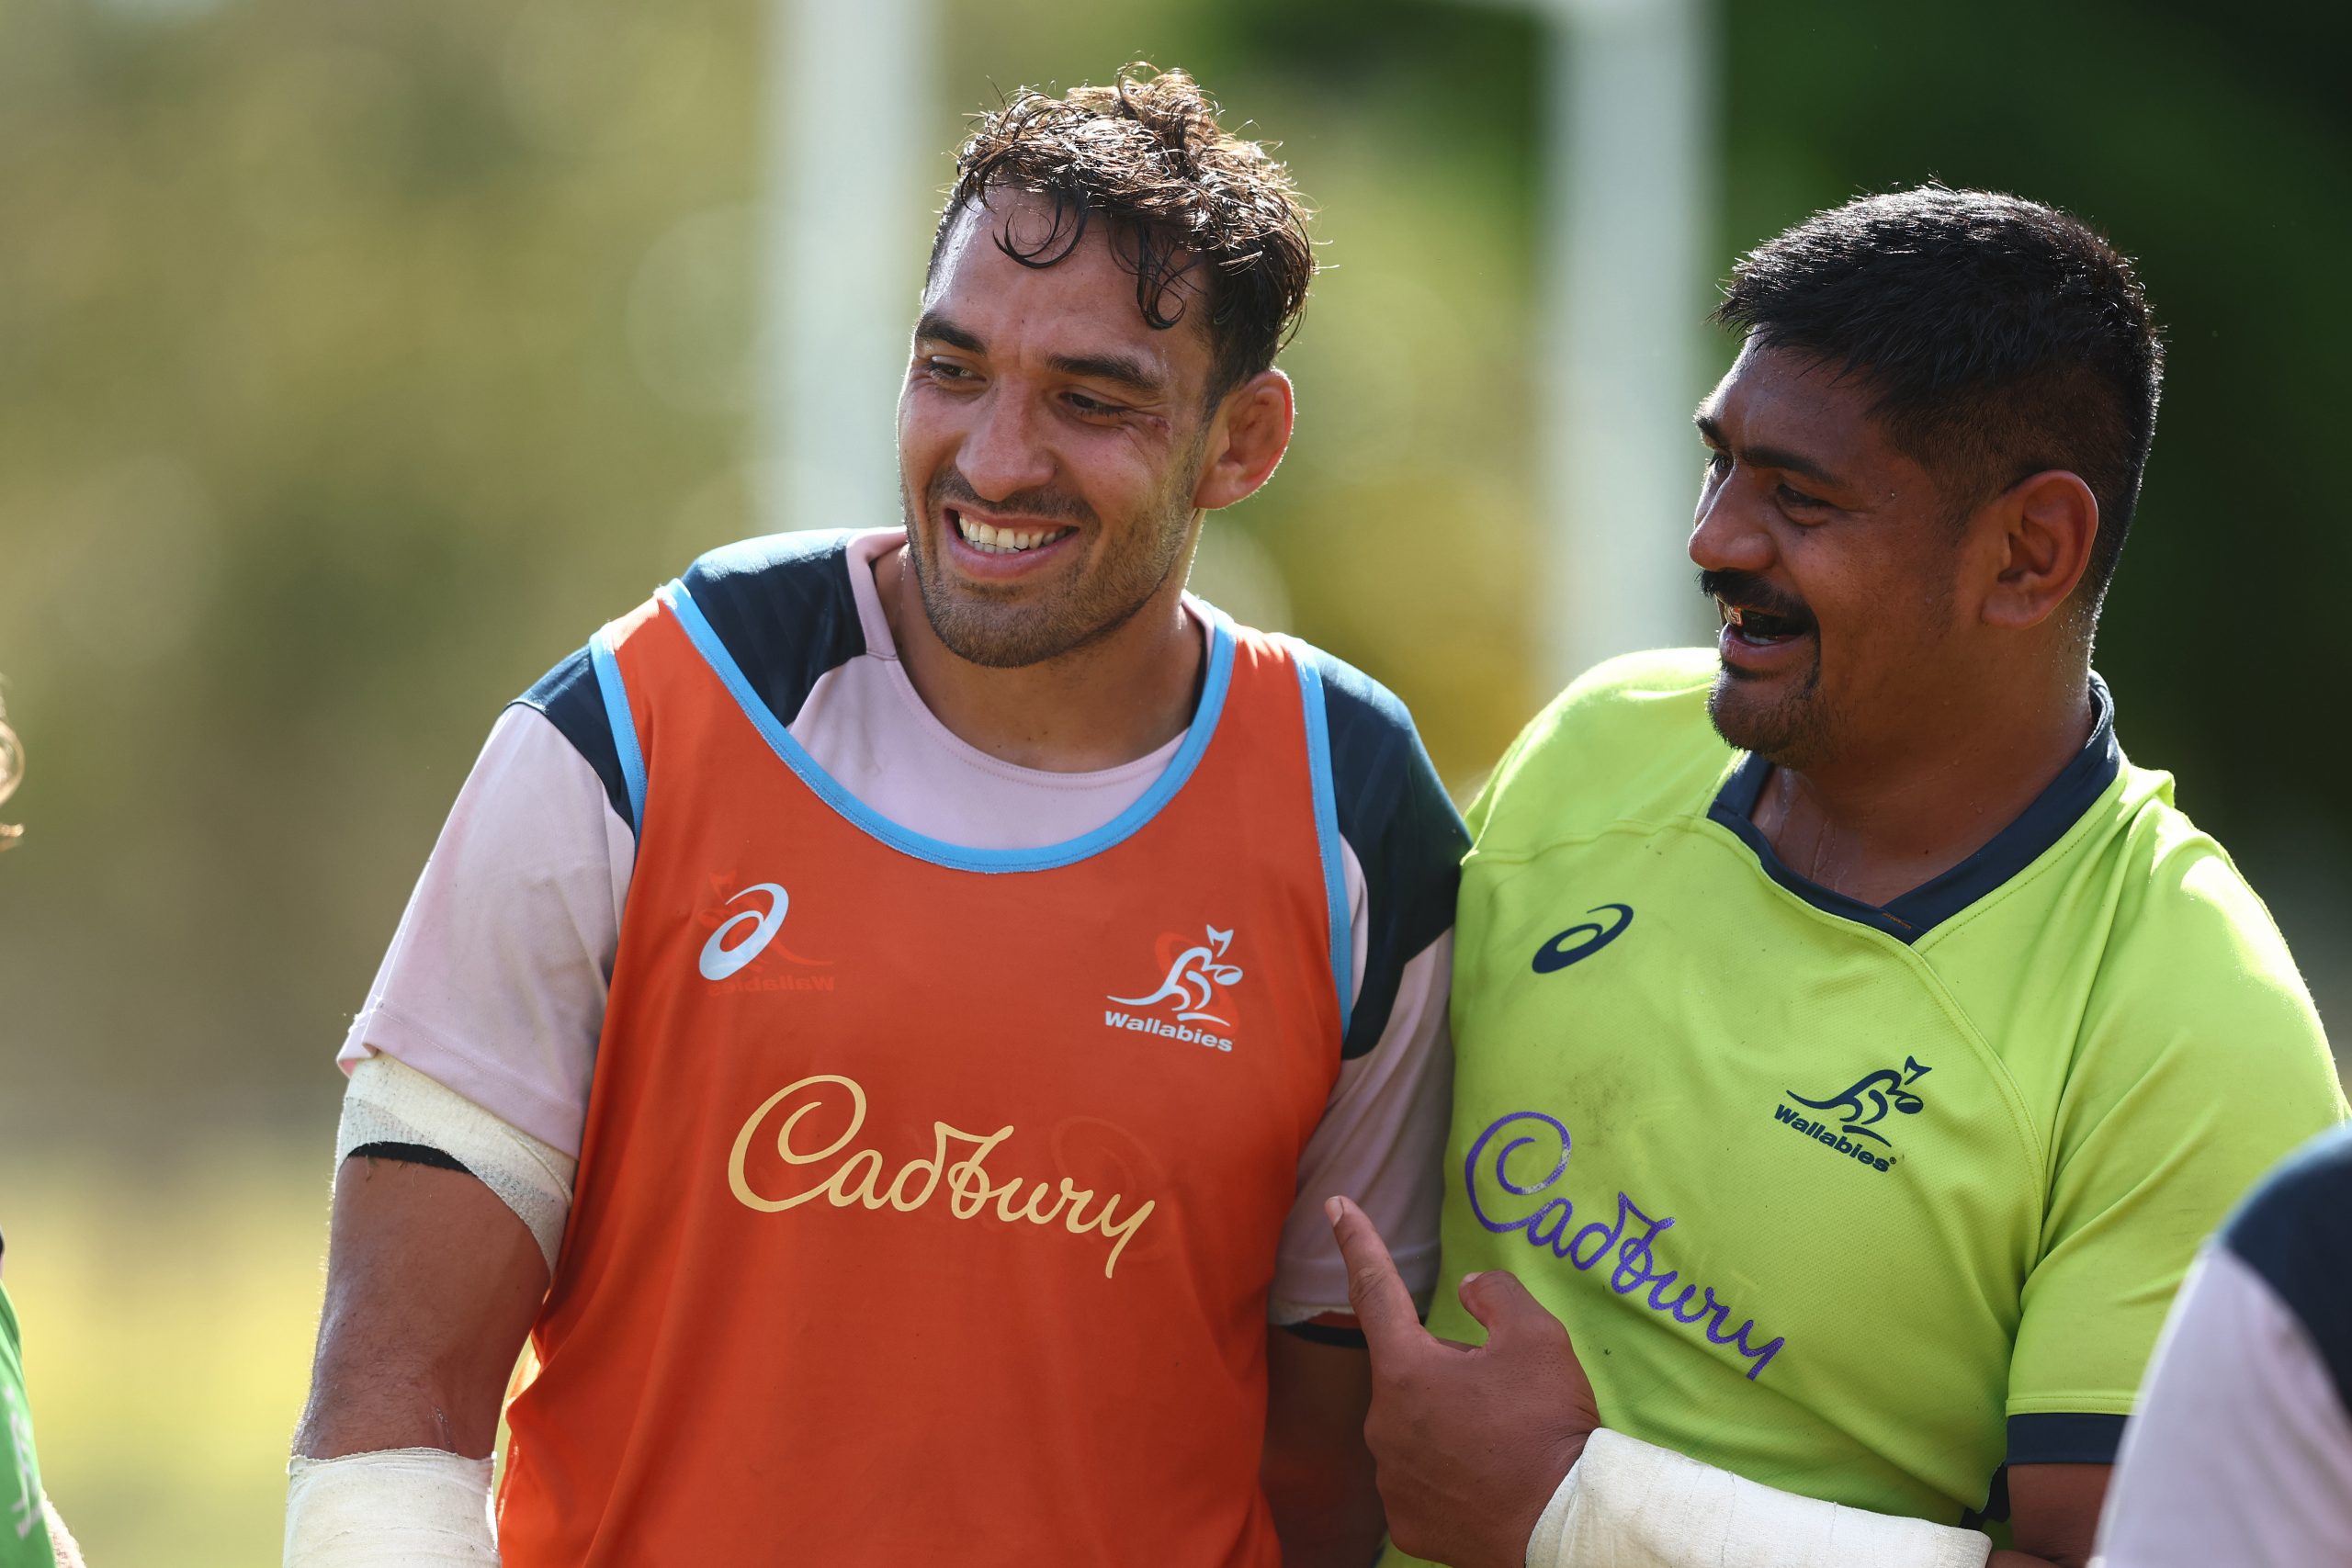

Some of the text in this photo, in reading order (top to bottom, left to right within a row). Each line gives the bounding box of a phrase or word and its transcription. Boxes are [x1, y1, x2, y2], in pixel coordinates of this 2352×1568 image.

[1104, 1010, 1234, 1053] Wallabies
[728, 1075, 1155, 1279] Cadbury
[1464, 1111, 1785, 1381] Cadbury
